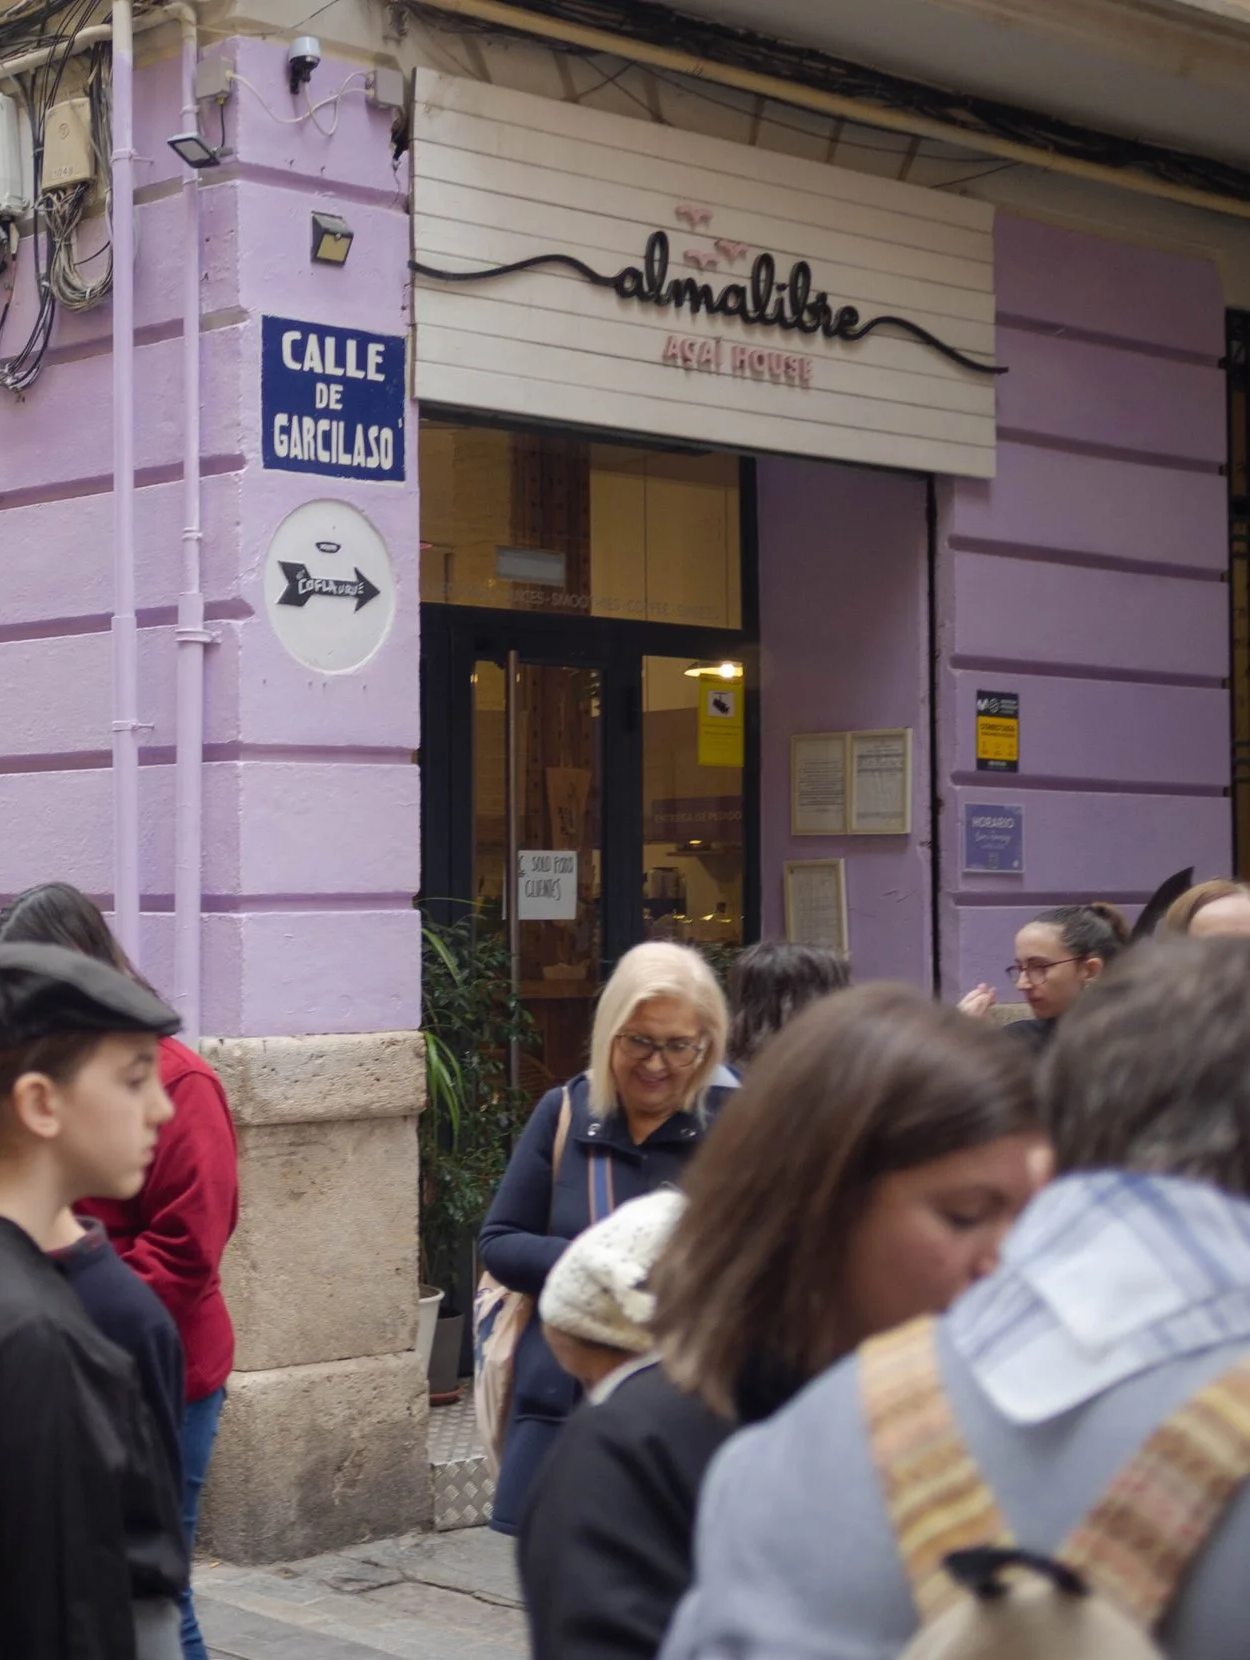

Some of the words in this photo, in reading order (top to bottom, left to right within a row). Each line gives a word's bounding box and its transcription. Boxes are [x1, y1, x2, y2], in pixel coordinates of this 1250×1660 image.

[614, 230, 861, 342] almalibre
[281, 330, 386, 382] CALLE
[731, 344, 815, 390] HOUSE
[314, 382, 344, 410] DE
[273, 413, 394, 471] GARCILASO
